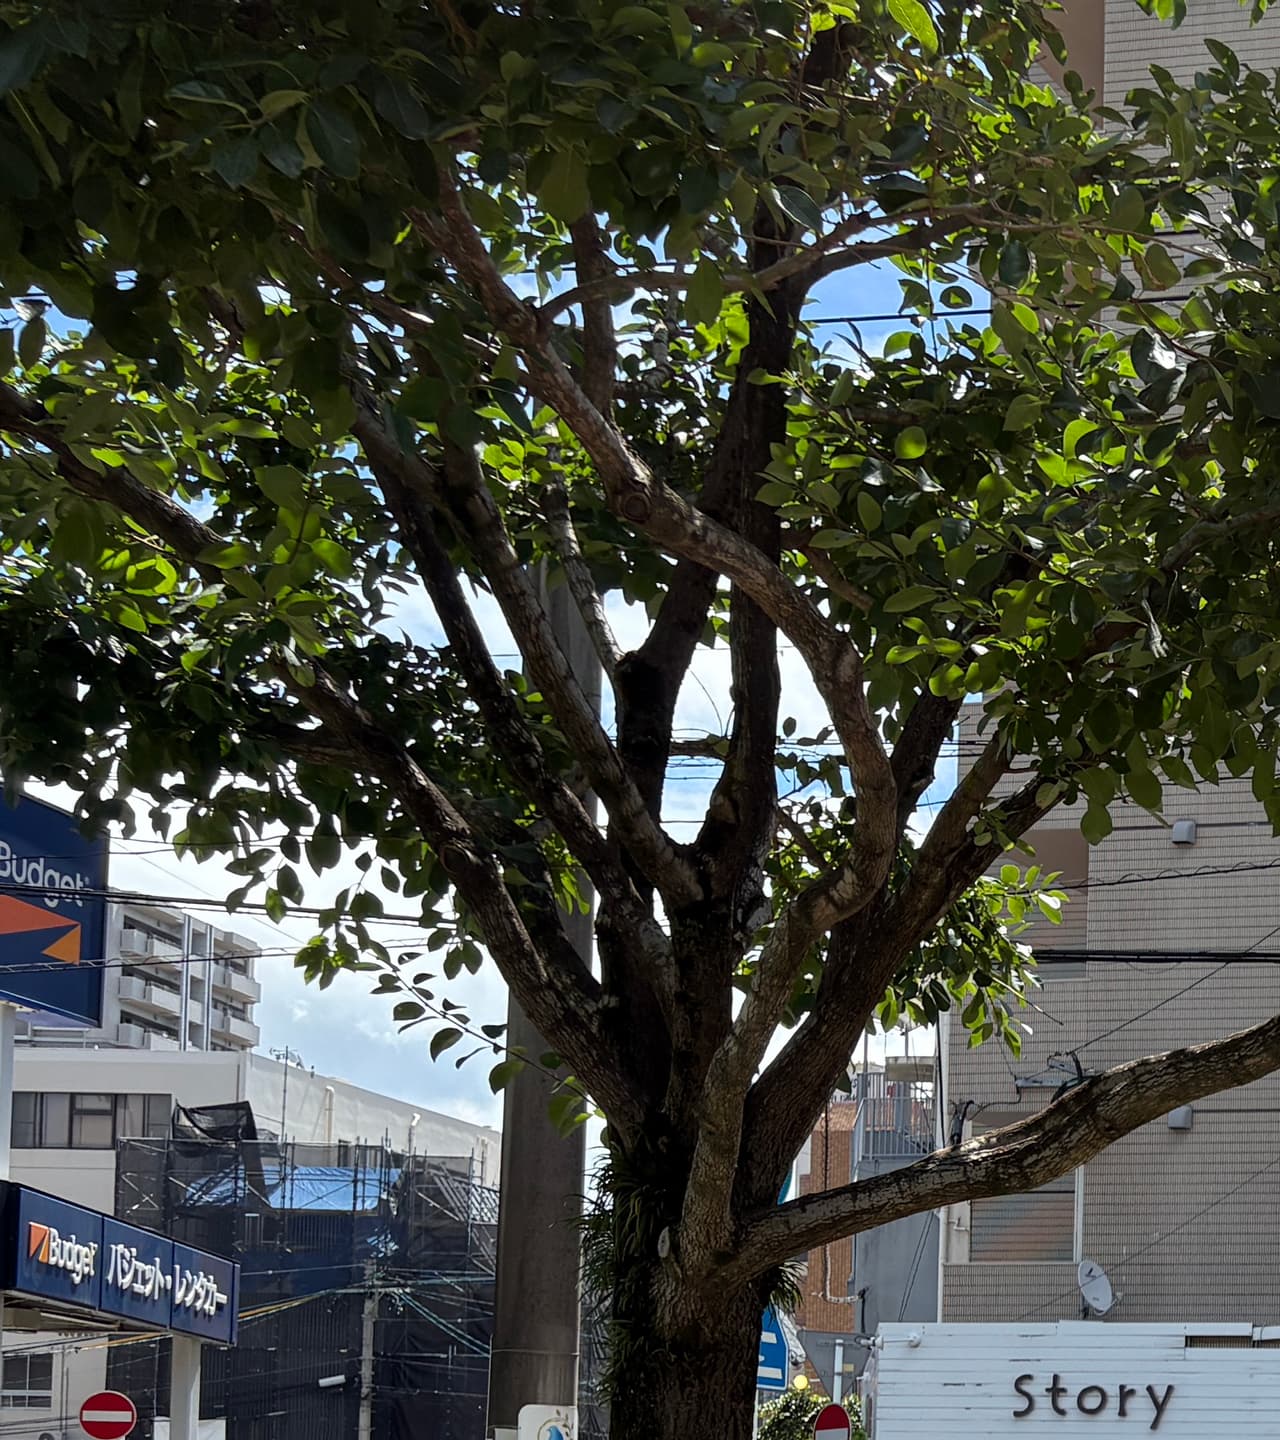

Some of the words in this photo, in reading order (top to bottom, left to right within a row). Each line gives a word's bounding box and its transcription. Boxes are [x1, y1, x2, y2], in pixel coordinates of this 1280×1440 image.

[0, 840, 83, 908] Budget
[49, 1227, 98, 1285] Budget
[1013, 1373, 1175, 1431] Story
